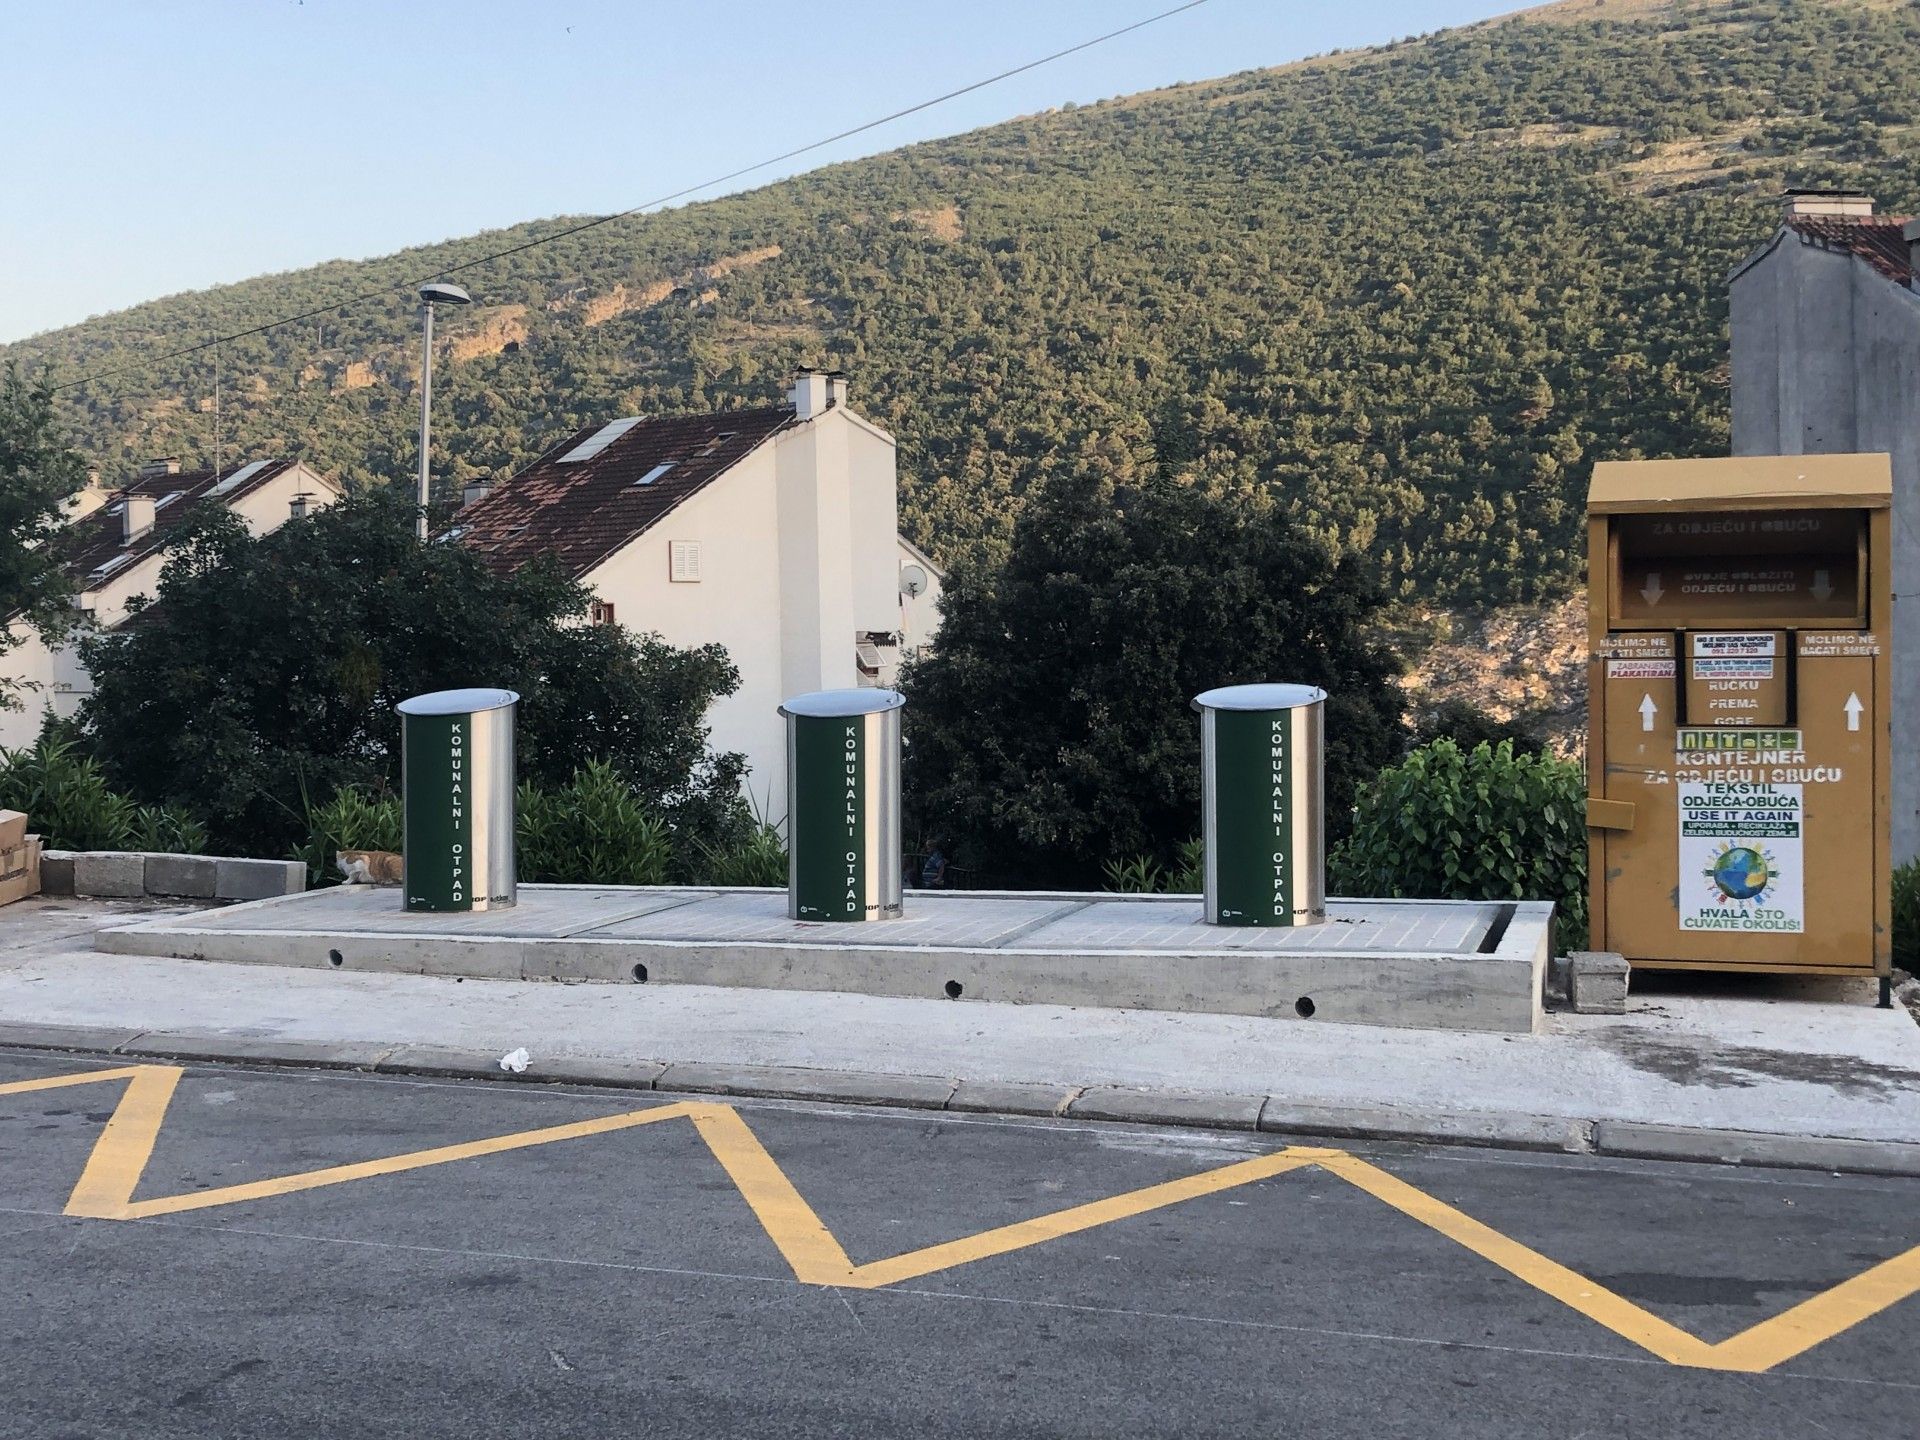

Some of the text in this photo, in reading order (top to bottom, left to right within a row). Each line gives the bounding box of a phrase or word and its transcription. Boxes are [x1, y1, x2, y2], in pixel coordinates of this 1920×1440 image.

[1600, 638, 1667, 647] MOLIMO NE
[1805, 635, 1877, 644] MOLIMO NE
[1709, 699, 1759, 708] PREMA
[1714, 717, 1754, 725] GORE
[1675, 750, 1806, 766] KONTEJNER
[1644, 770, 1669, 784] ZA
[1675, 767, 1753, 784] ODJEĆU
[1771, 765, 1842, 783] OBUĆU
[1704, 783, 1777, 794] TEKSTIL
[1682, 794, 1799, 807] ODJEĆA-OBUĆA
[451, 724, 463, 902] KOMUNALNI OTPAD
[1271, 721, 1284, 916] KOMUNALNI OTPAD
[1688, 811, 1793, 820] USE IT AGAIN
[845, 727, 856, 912] KOMUNALNI OTPAD
[1700, 909, 1749, 918] HVALA
